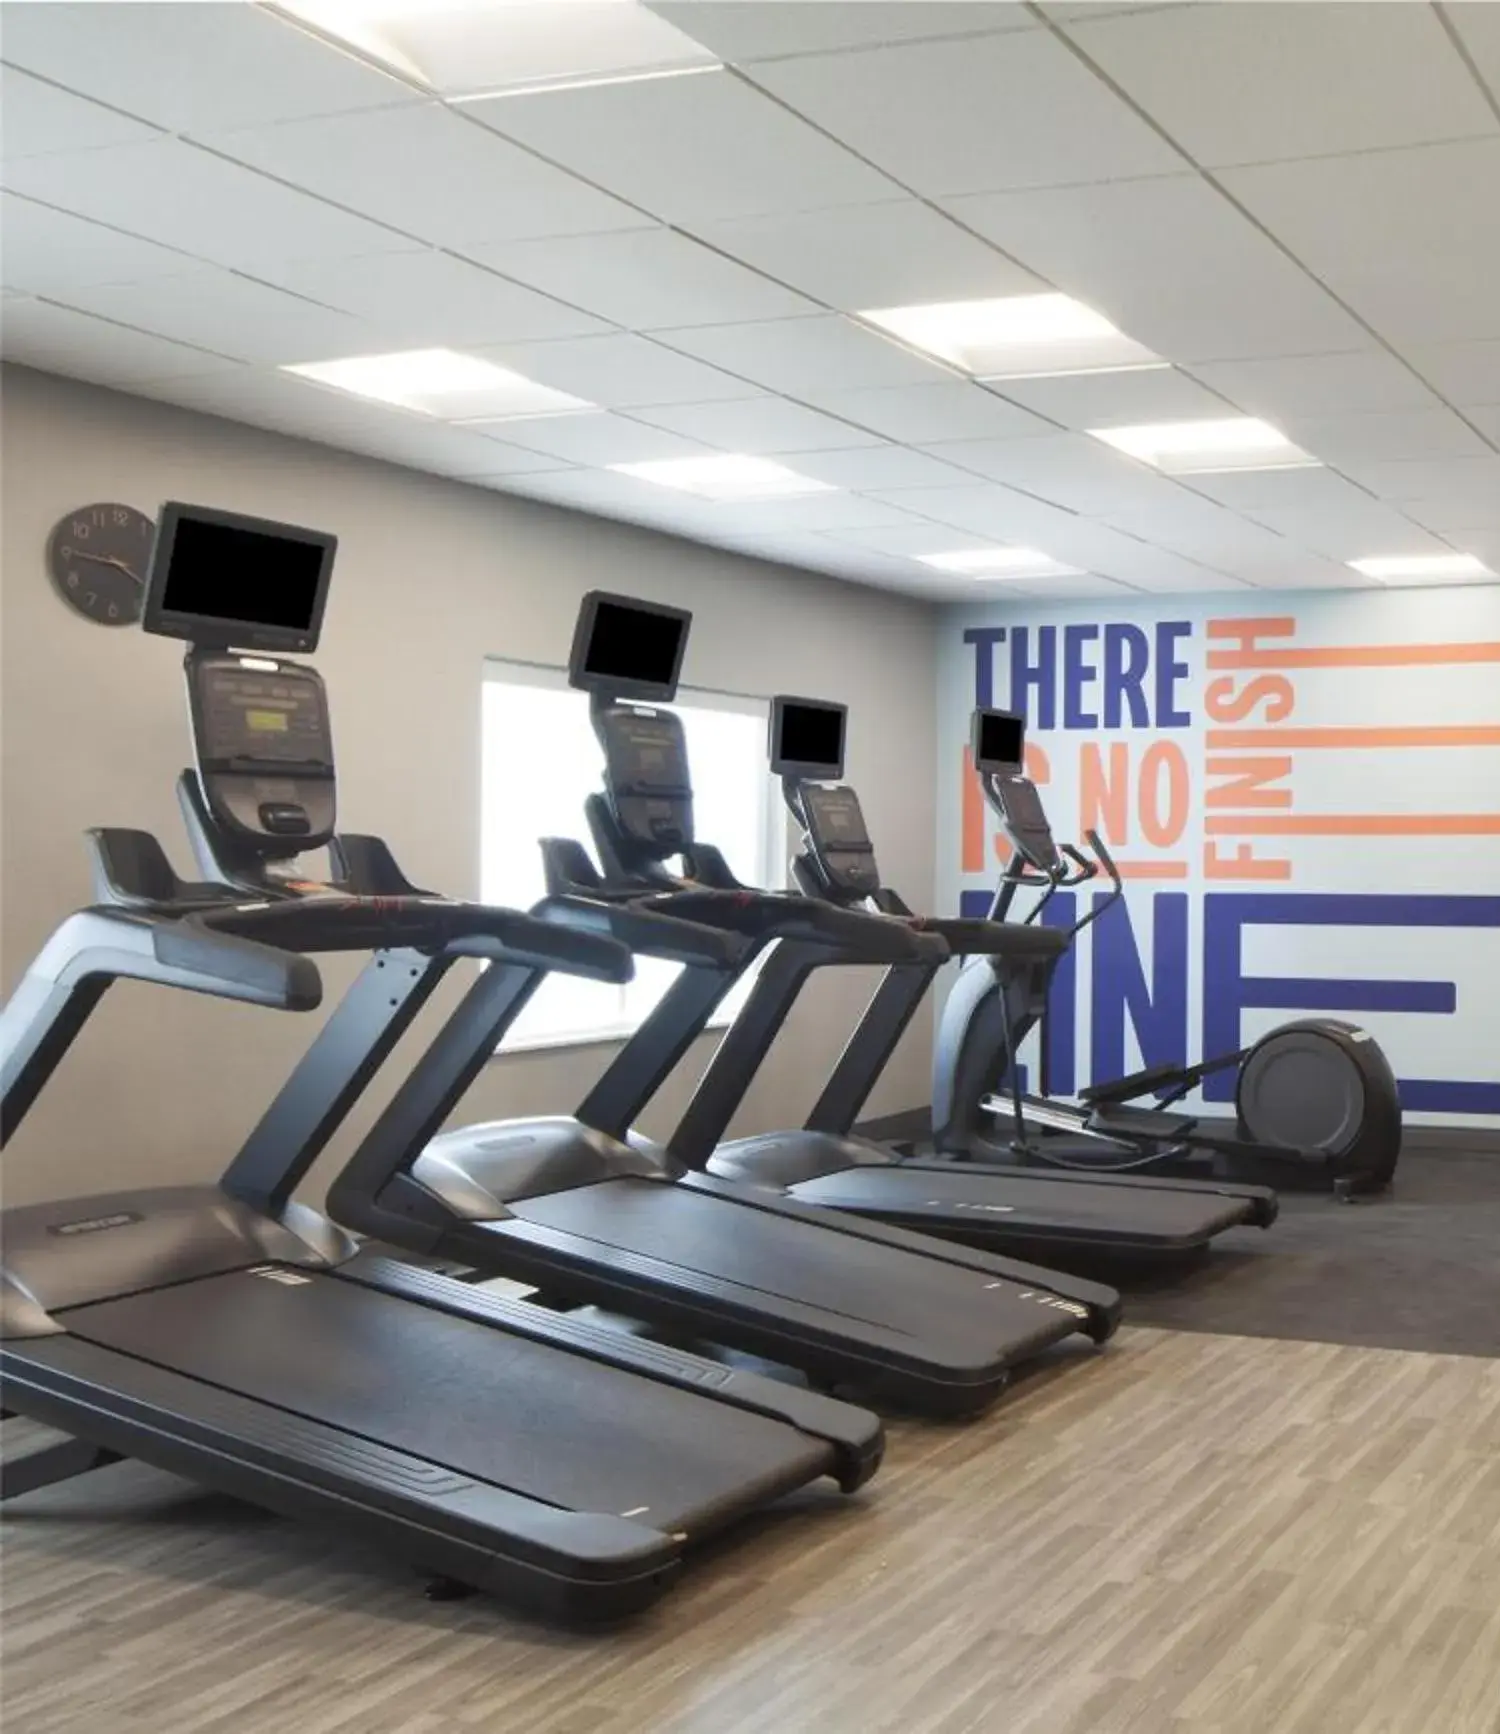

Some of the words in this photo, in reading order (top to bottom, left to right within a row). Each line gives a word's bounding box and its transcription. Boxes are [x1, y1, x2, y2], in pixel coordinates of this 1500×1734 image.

[112, 509, 129, 528] 12
[72, 520, 91, 540] 10
[85, 591, 99, 607] 7
[107, 602, 119, 618] 6
[963, 621, 1193, 731] THERE
[1203, 617, 1296, 881] FINISH
[1079, 739, 1190, 848] NO
